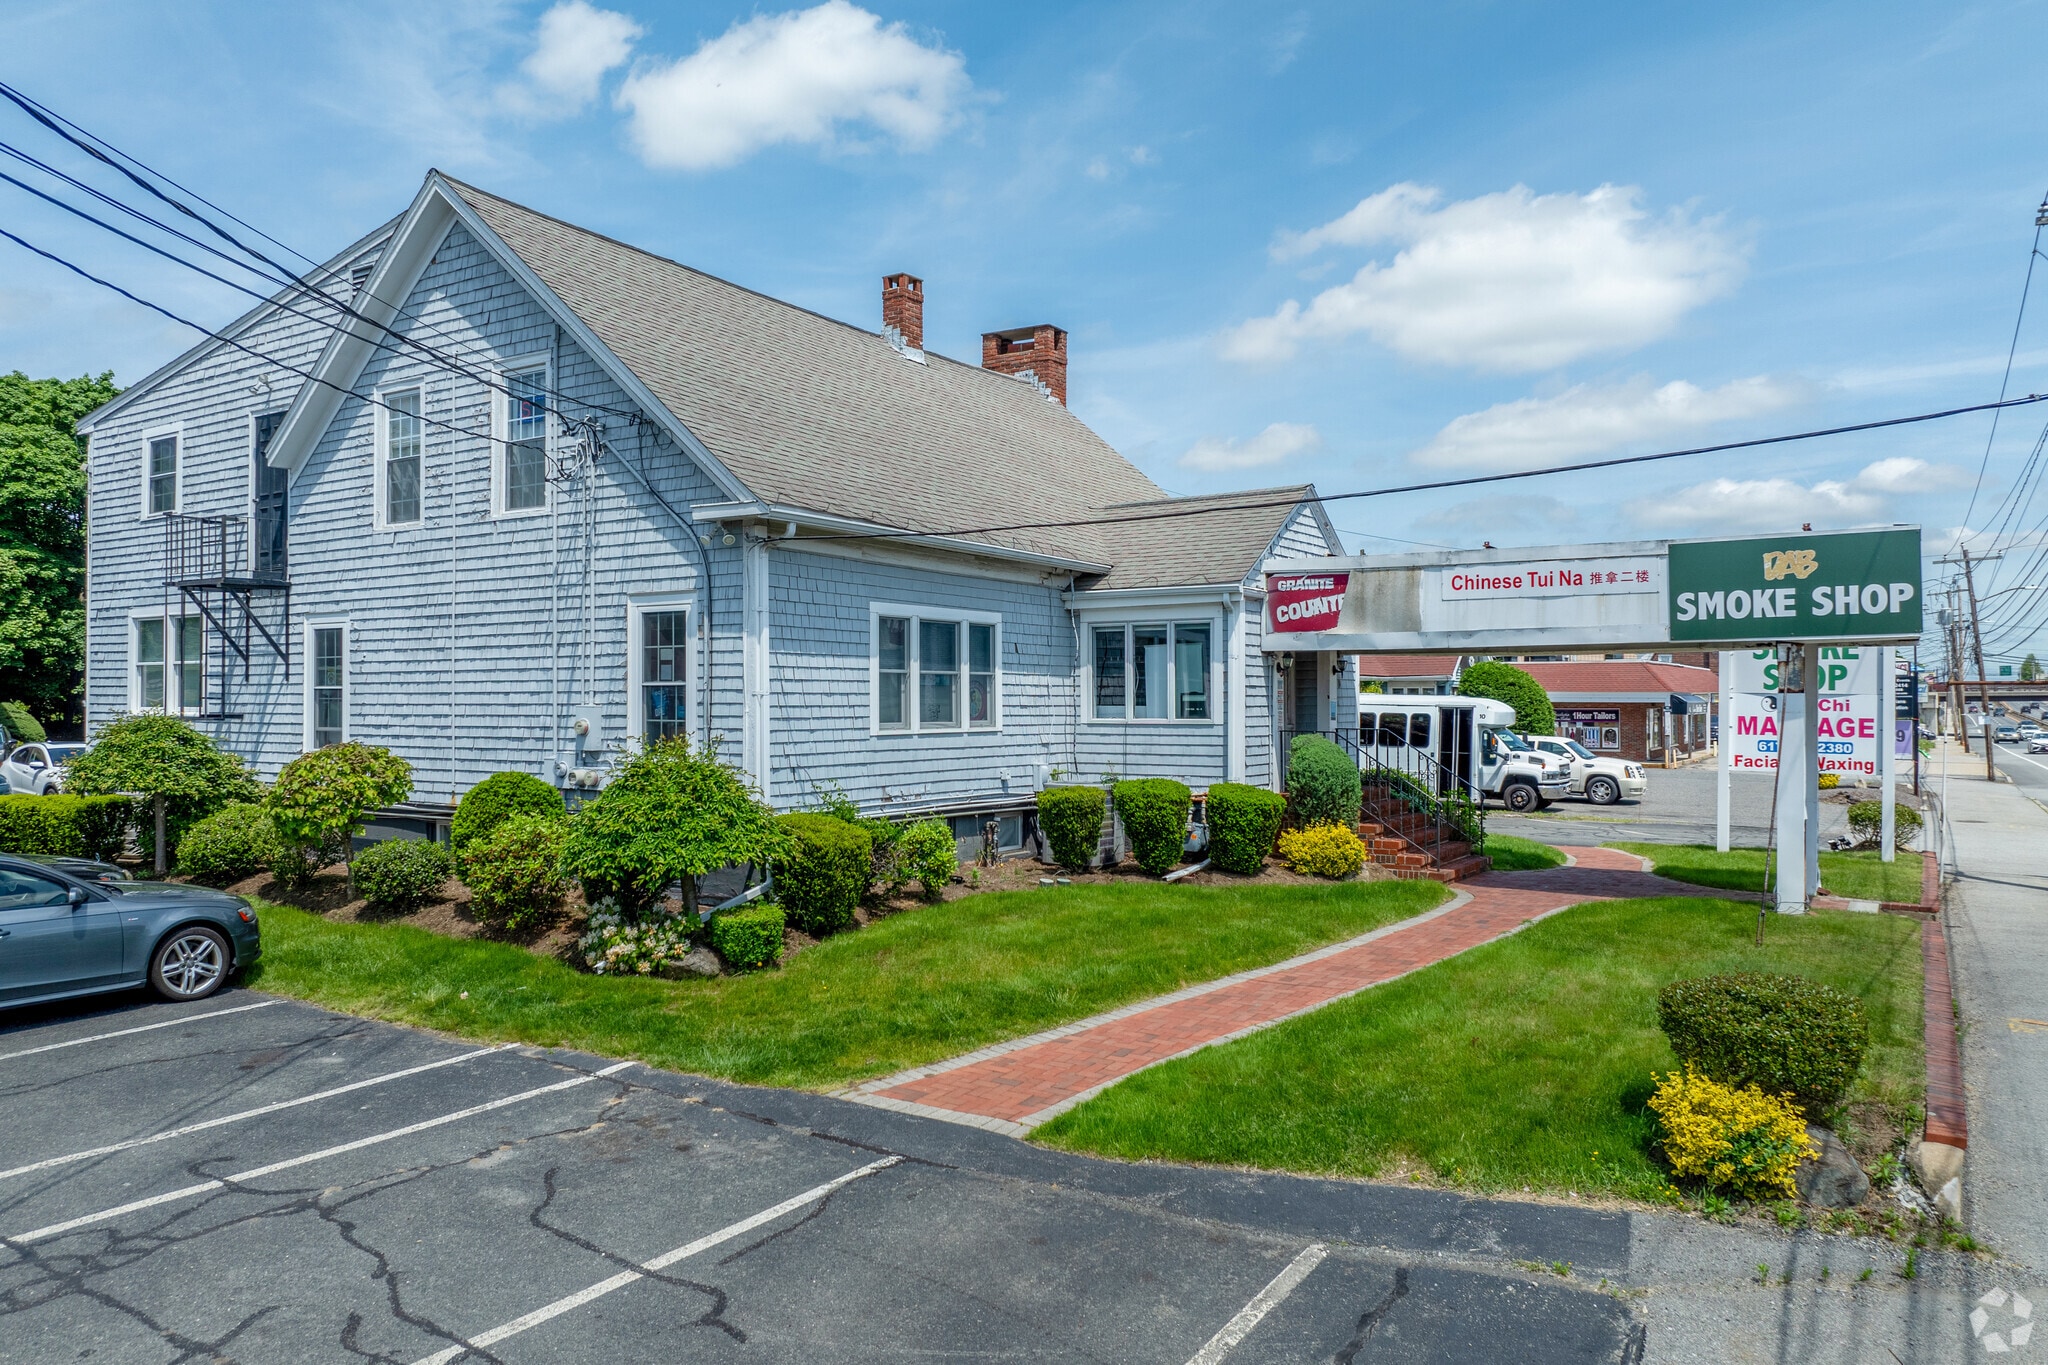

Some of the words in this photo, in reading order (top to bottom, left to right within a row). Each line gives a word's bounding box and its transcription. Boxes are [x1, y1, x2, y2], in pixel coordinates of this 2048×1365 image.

[1763, 549, 1819, 581] DAB
[1277, 578, 1335, 592] GRANITE
[1451, 575, 1523, 591] Chinese
[1527, 571, 1554, 588] Tui
[1559, 570, 1583, 587] Na
[1590, 569, 1650, 585] 推拿二楼
[1676, 588, 1797, 621] SMOKE
[1811, 582, 1915, 617] SHOP
[1818, 699, 1850, 712] Chi
[1593, 711, 1616, 720] Tailors
[1737, 716, 1875, 738] MAAGE
[1734, 755, 1779, 768] Facia
